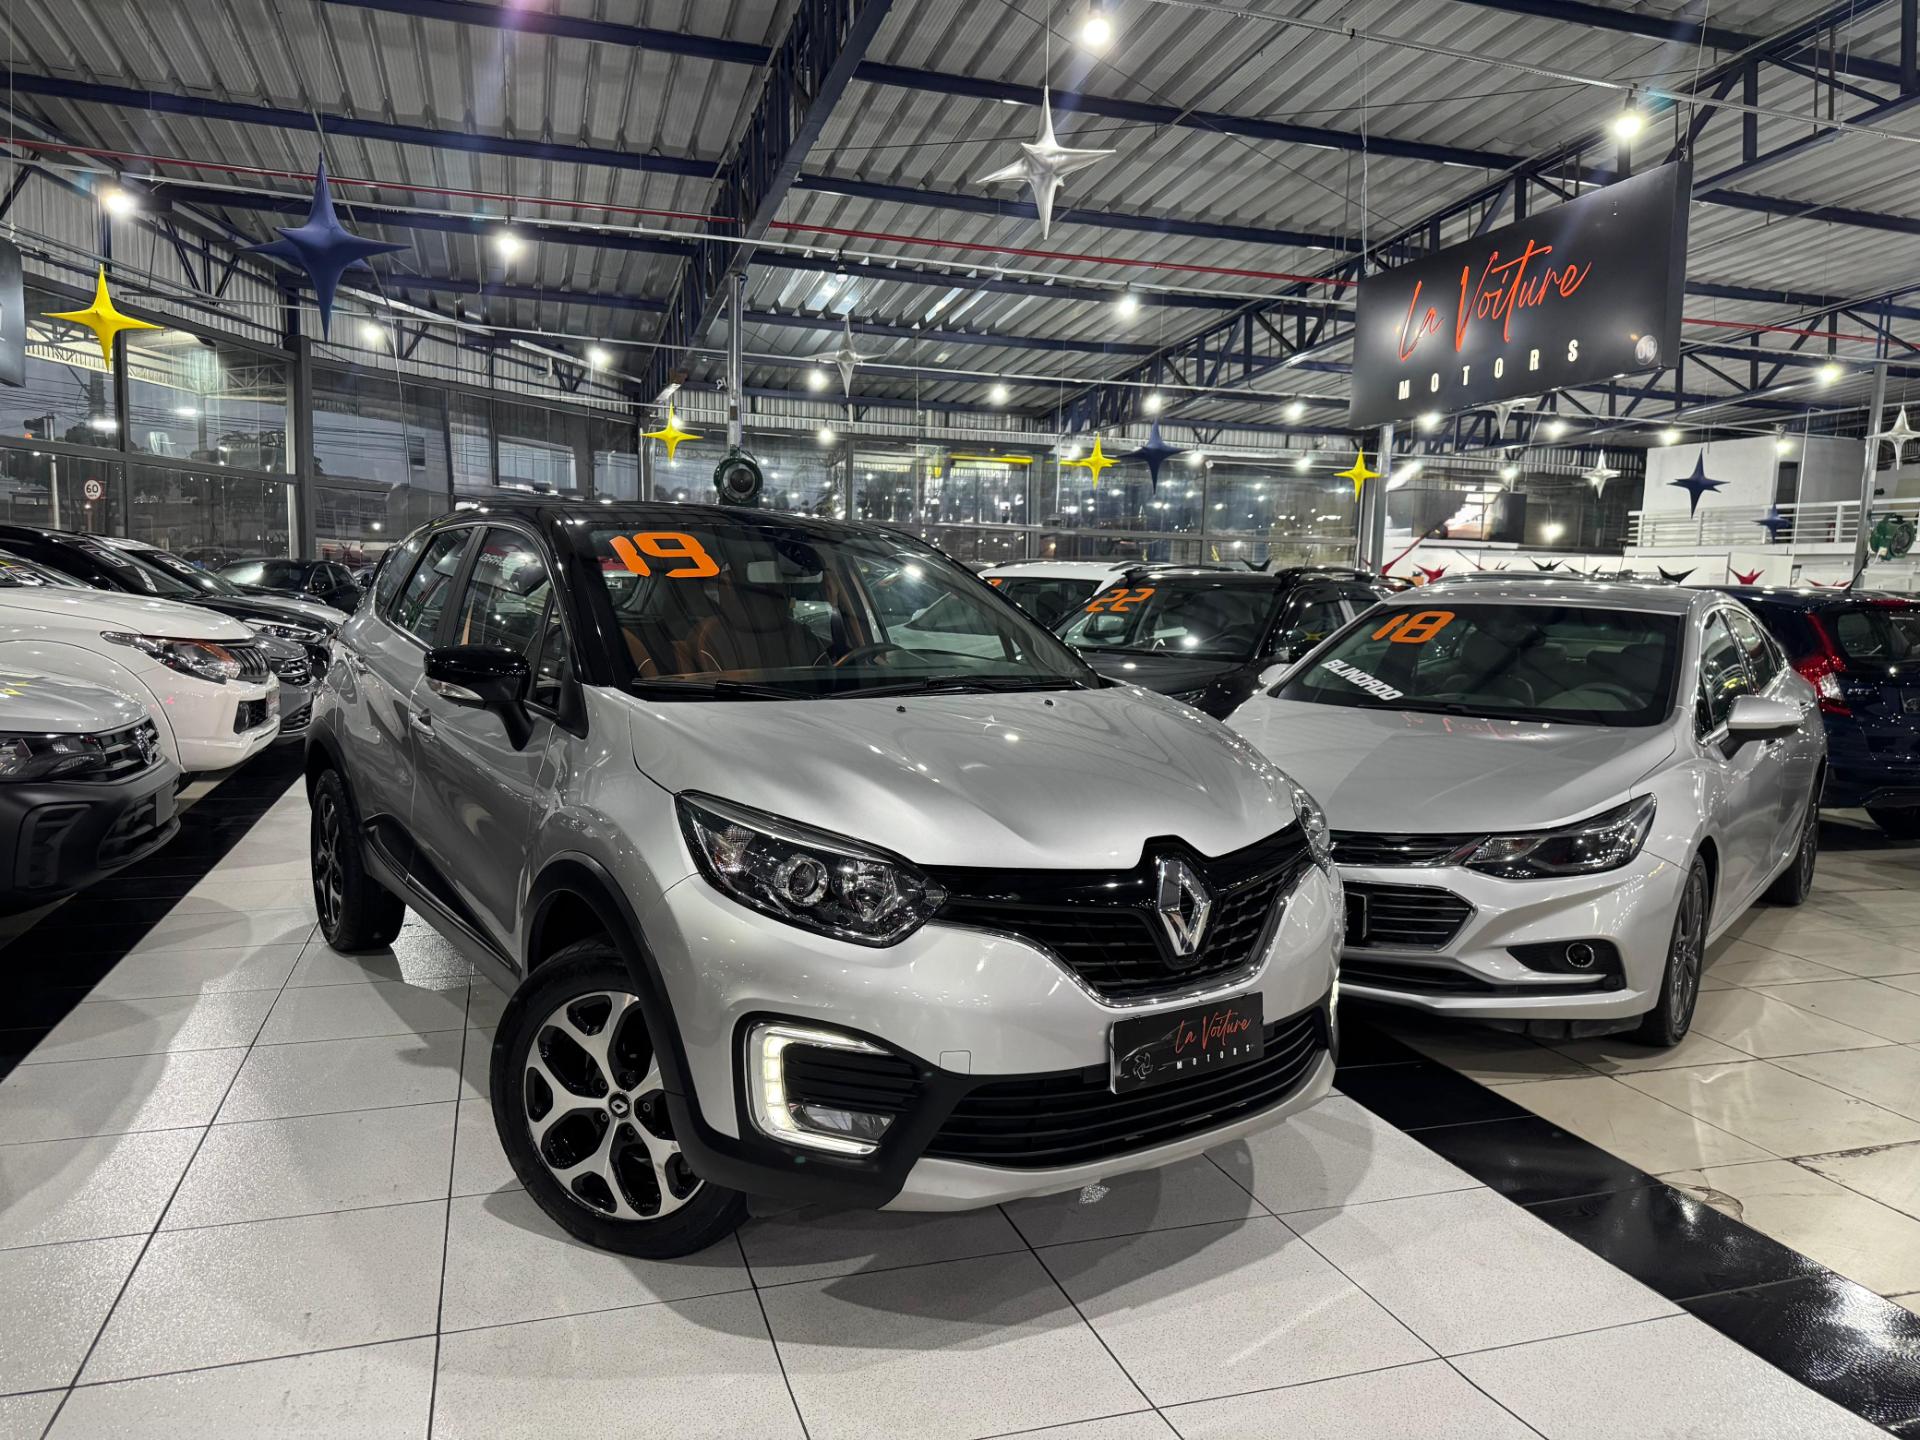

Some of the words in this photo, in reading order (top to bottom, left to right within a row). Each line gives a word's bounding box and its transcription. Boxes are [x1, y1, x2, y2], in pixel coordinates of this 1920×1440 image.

[1398, 280, 1445, 362] La
[1455, 239, 1592, 353] Voiture
[1398, 339, 1579, 400] MOTORS
[86, 483, 99, 493] 60
[608, 531, 721, 578] 19
[1085, 588, 1156, 612] 22
[1371, 610, 1456, 644] 18
[1320, 658, 1405, 701] BLINDADO
[1175, 1020, 1197, 1054] La
[1202, 1009, 1252, 1050] Voiture
[1176, 1043, 1251, 1070] MOTORS
